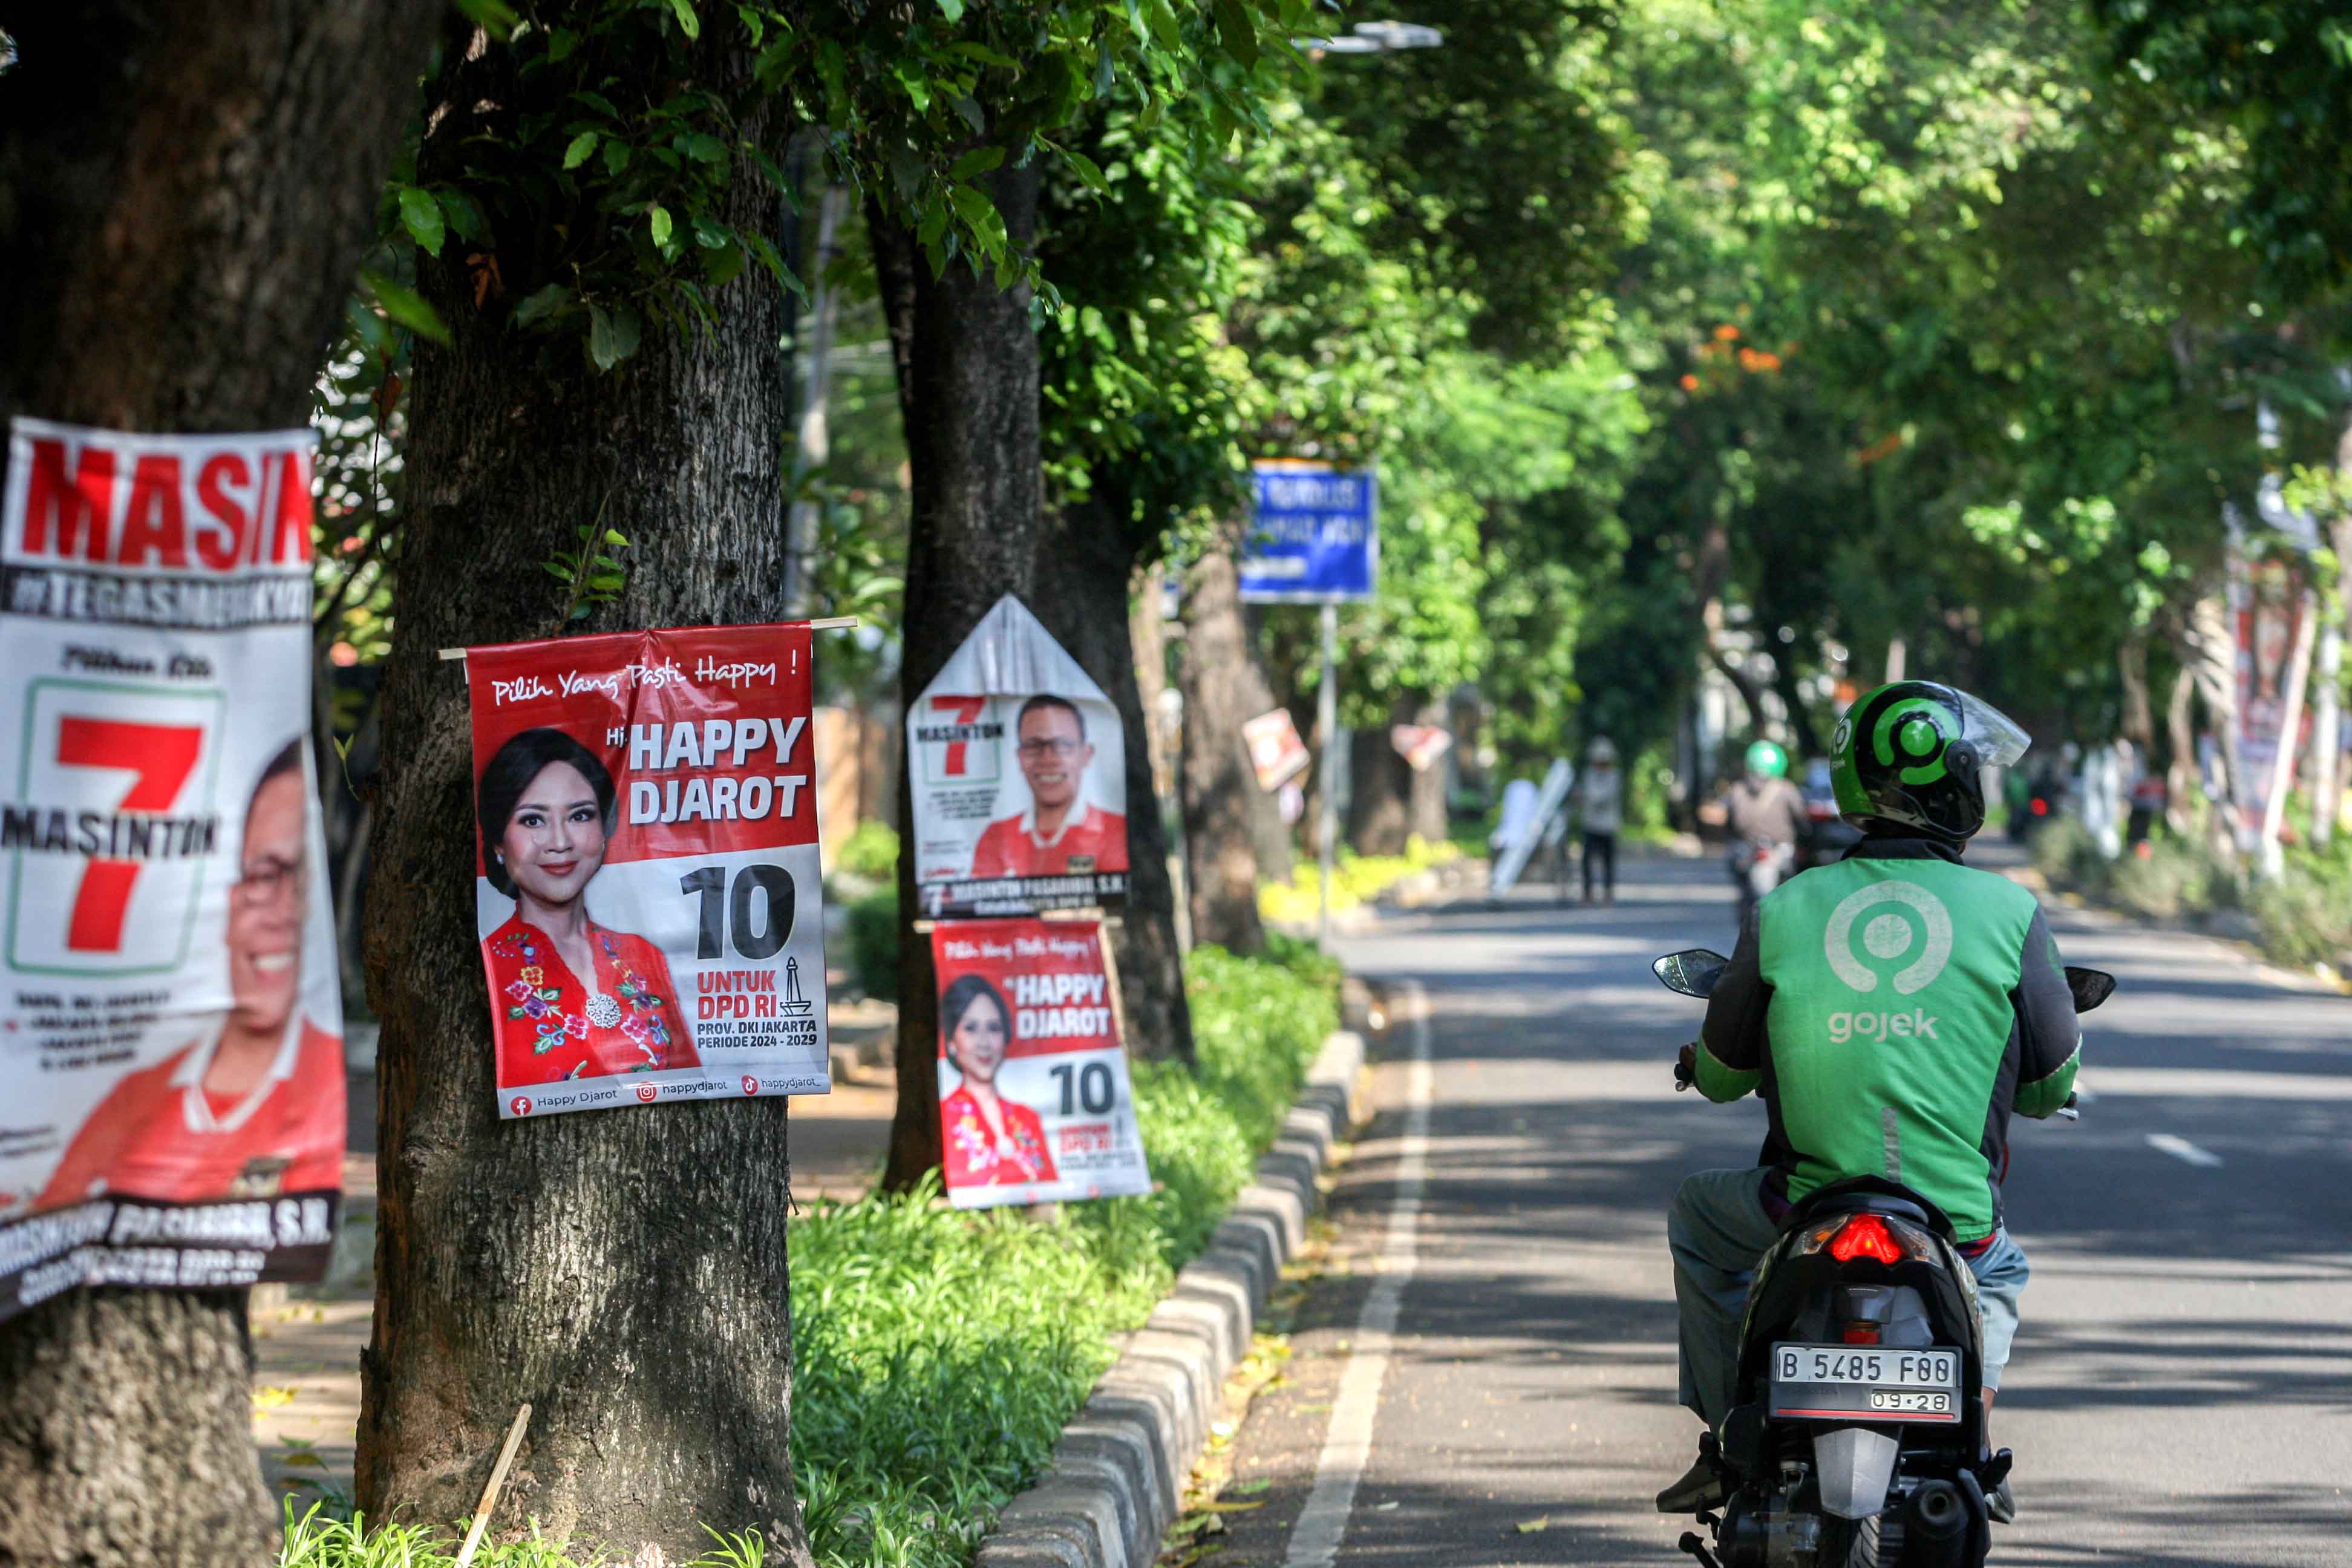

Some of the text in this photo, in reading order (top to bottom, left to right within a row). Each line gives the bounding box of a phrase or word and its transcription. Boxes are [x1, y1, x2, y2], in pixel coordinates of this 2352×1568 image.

[491, 676, 553, 707] Pilih
[558, 670, 618, 699] Yang
[626, 656, 687, 689] Pasti
[695, 655, 776, 689] Happy
[606, 716, 806, 770] Hj. HAPPY
[917, 722, 1005, 742] MASINTON
[932, 695, 986, 775] 7
[630, 774, 806, 825] DJAROT
[56, 714, 203, 953] 7
[680, 864, 795, 960] 10
[697, 970, 776, 994] UNTUK
[1016, 973, 1105, 1006] HAPPY
[697, 995, 777, 1019] DPD RI
[1016, 1007, 1111, 1040] DJAROT
[697, 1020, 816, 1035] PROV. DKI JAKARTA
[697, 1036, 748, 1049] PERIODE
[750, 1035, 777, 1048] 2024
[786, 1034, 817, 1047] 2029
[1828, 1007, 1938, 1044] gojek
[537, 1089, 617, 1108] Happy Djarot
[662, 1080, 728, 1096] happydjarot
[1049, 1062, 1114, 1115] 10
[1784, 1353, 1797, 1378] B
[1815, 1354, 1881, 1380] 5485
